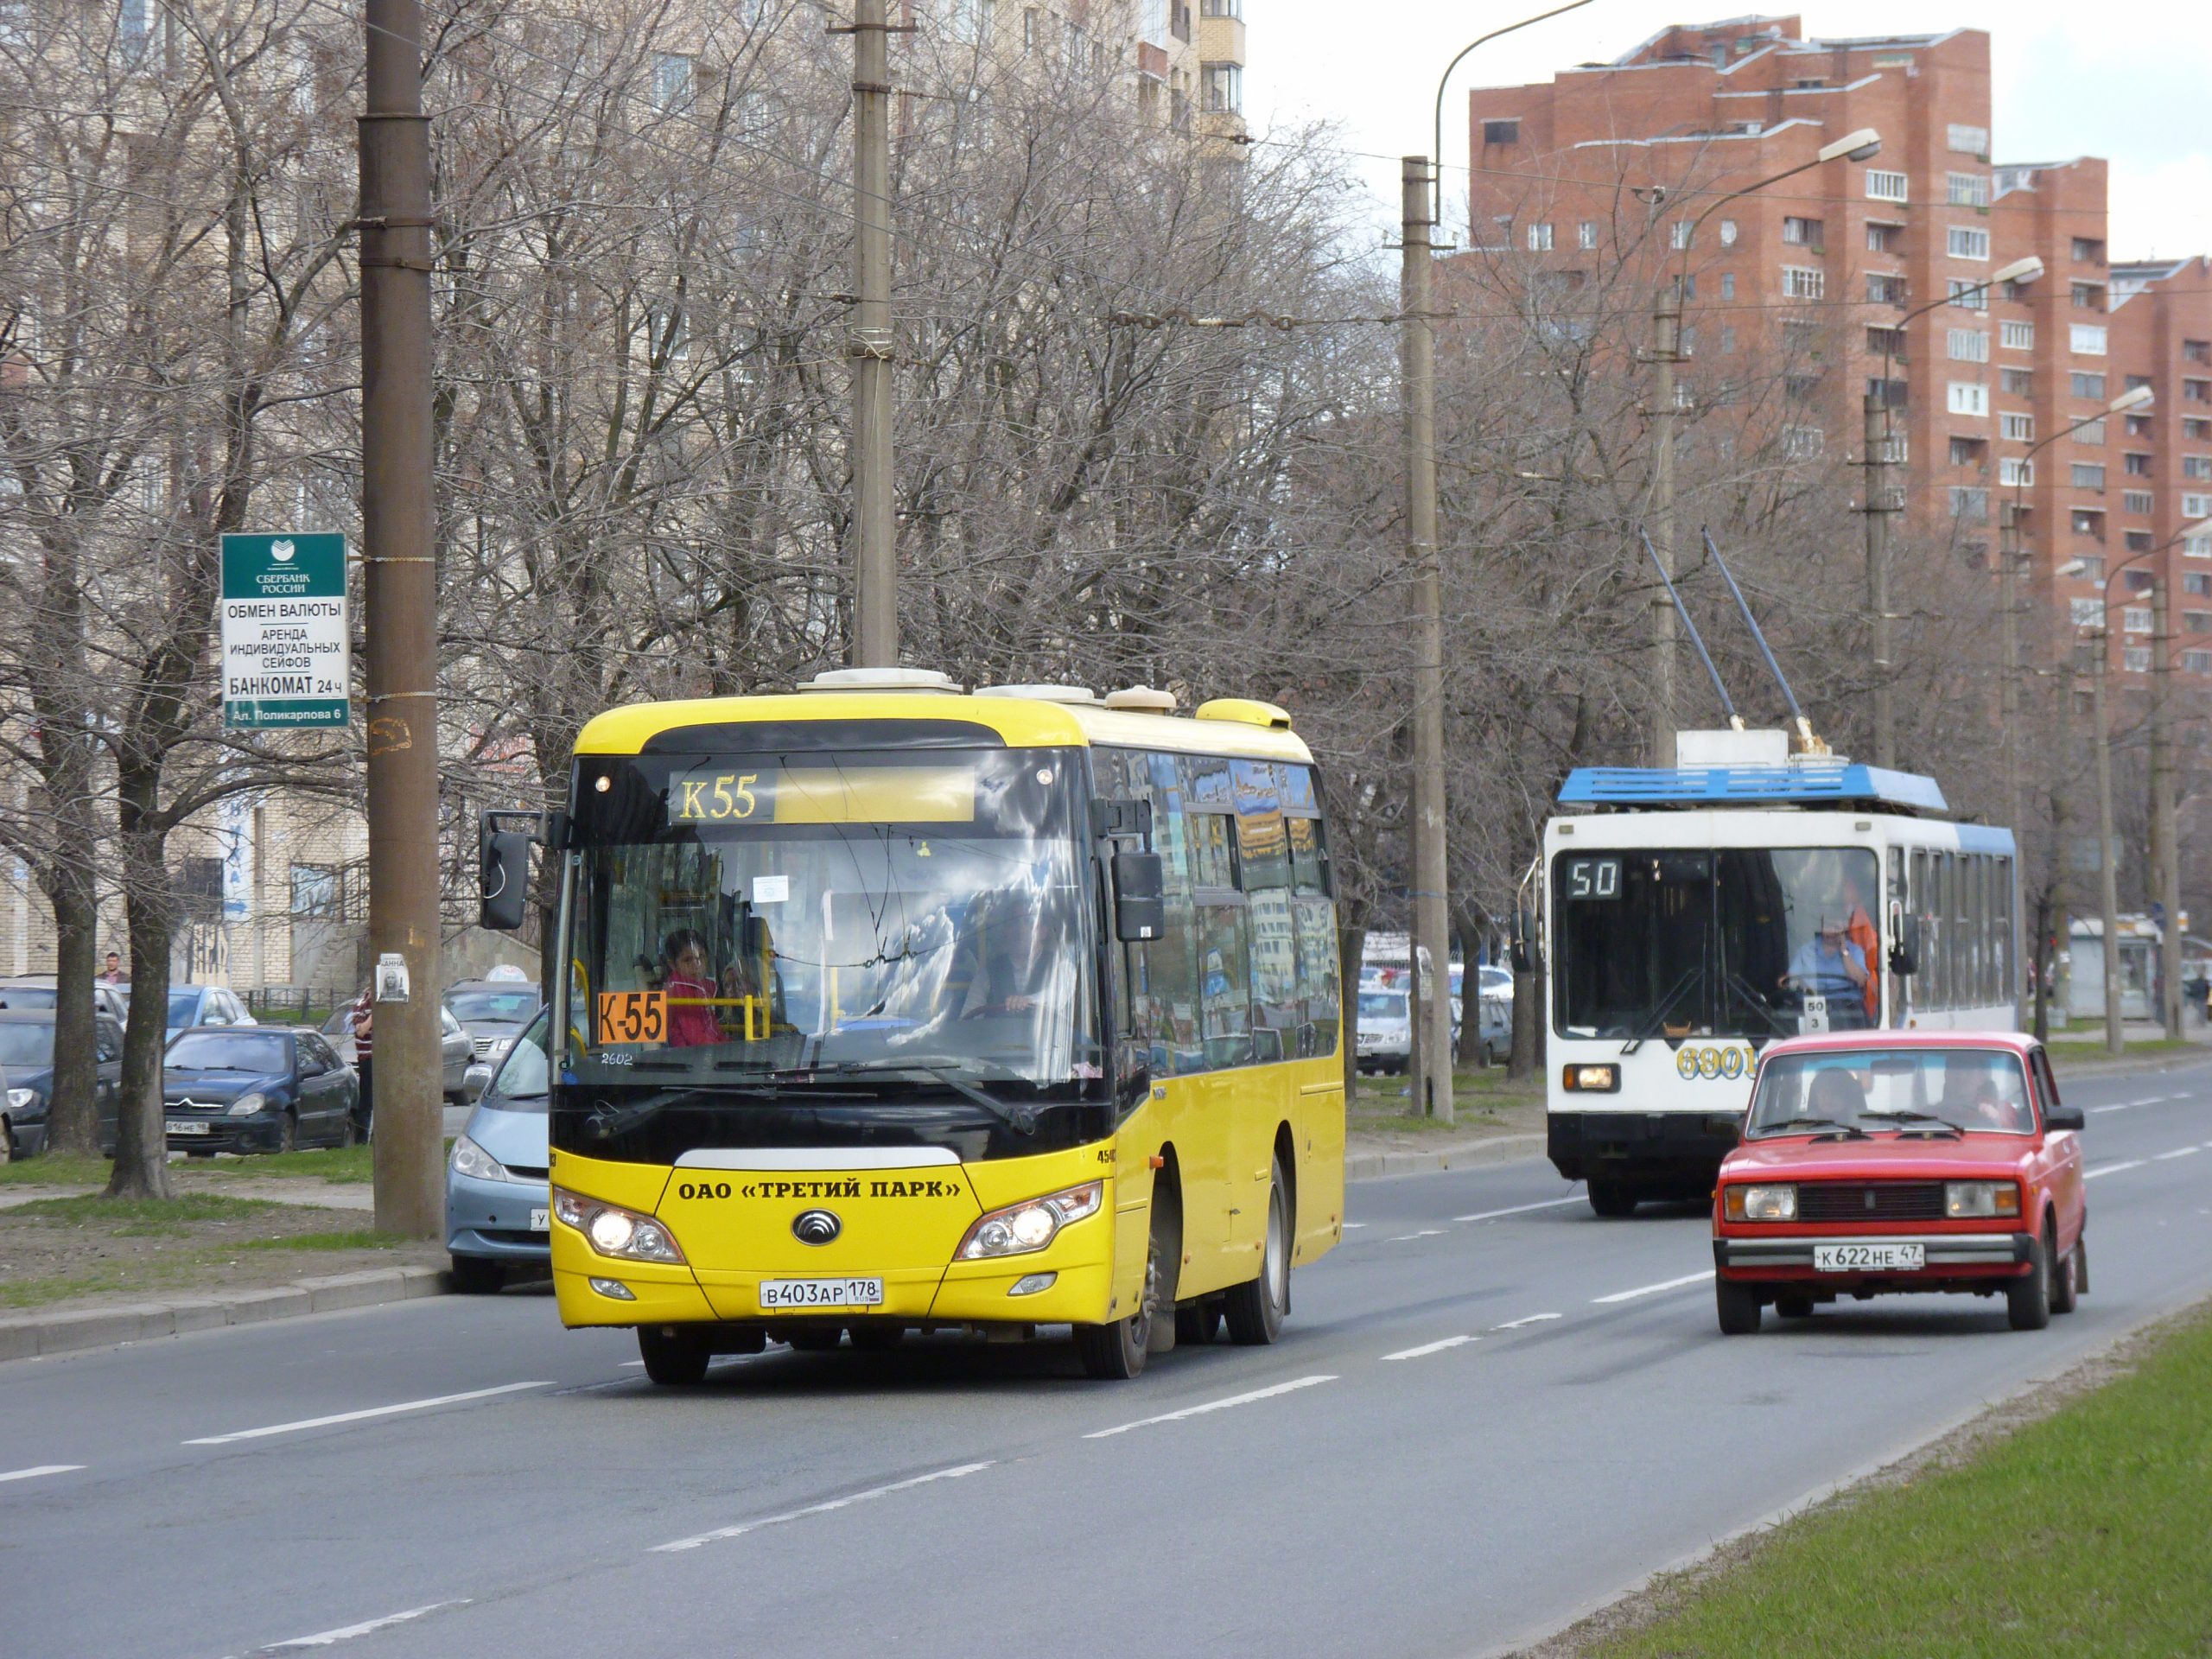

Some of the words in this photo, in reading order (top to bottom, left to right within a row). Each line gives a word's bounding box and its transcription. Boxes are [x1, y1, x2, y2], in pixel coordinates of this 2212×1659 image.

[256, 574, 311, 584] СБЕРБАНК
[262, 584, 305, 594] РОССИИ
[228, 604, 276, 618] ОБМЕН
[280, 602, 341, 617] ВАЛЮТЫ
[261, 628, 308, 641] АРЕНДА
[230, 642, 341, 656] ИНДИВИДУАЛЬНЫХ
[262, 654, 311, 669] СЕЙФОВ
[229, 676, 313, 696] БАНКОМАТ
[317, 679, 333, 693] 24
[255, 709, 332, 722] Поликарпова
[334, 709, 341, 719] 6
[1573, 862, 1617, 896] 50
[1808, 1001, 1824, 1012] 50
[600, 993, 663, 1041] К-55
[1811, 1018, 1820, 1029] 3
[601, 1052, 633, 1066] 2602
[678, 1182, 733, 1200] ОАО
[741, 1177, 861, 1199] «ТРЕТИЙ
[869, 1179, 962, 1198] ПАРК»
[1821, 1247, 1894, 1266] К622НЕ
[1901, 1245, 1917, 1260] 47
[766, 1283, 843, 1304] В403АР
[848, 1281, 876, 1297] 178
